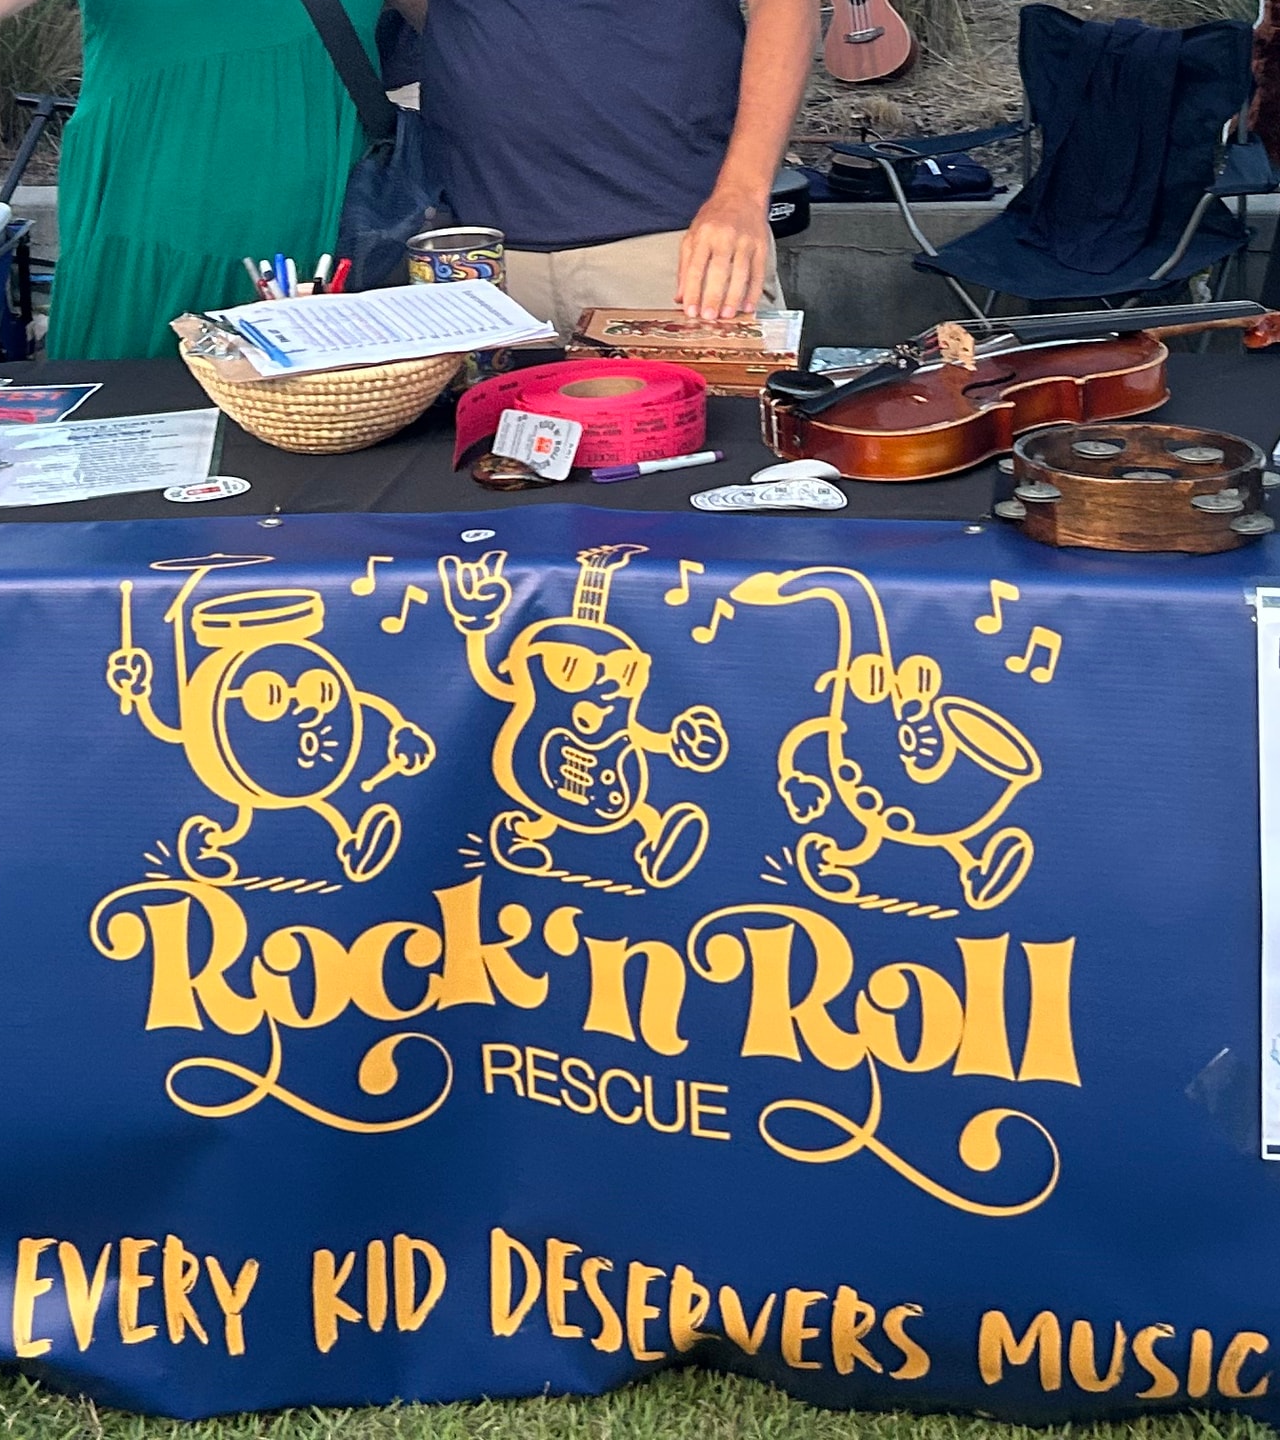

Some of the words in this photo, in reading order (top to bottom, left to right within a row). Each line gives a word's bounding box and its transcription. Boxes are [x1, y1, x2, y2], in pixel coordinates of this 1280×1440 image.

[483, 1041, 732, 1142] RESCUE
[687, 902, 1082, 1150] Roll
[12, 1233, 260, 1358] EVERY
[311, 1233, 448, 1354] KID
[490, 1227, 932, 1381] DESERVERS
[978, 1308, 1271, 1400] MUSIC
